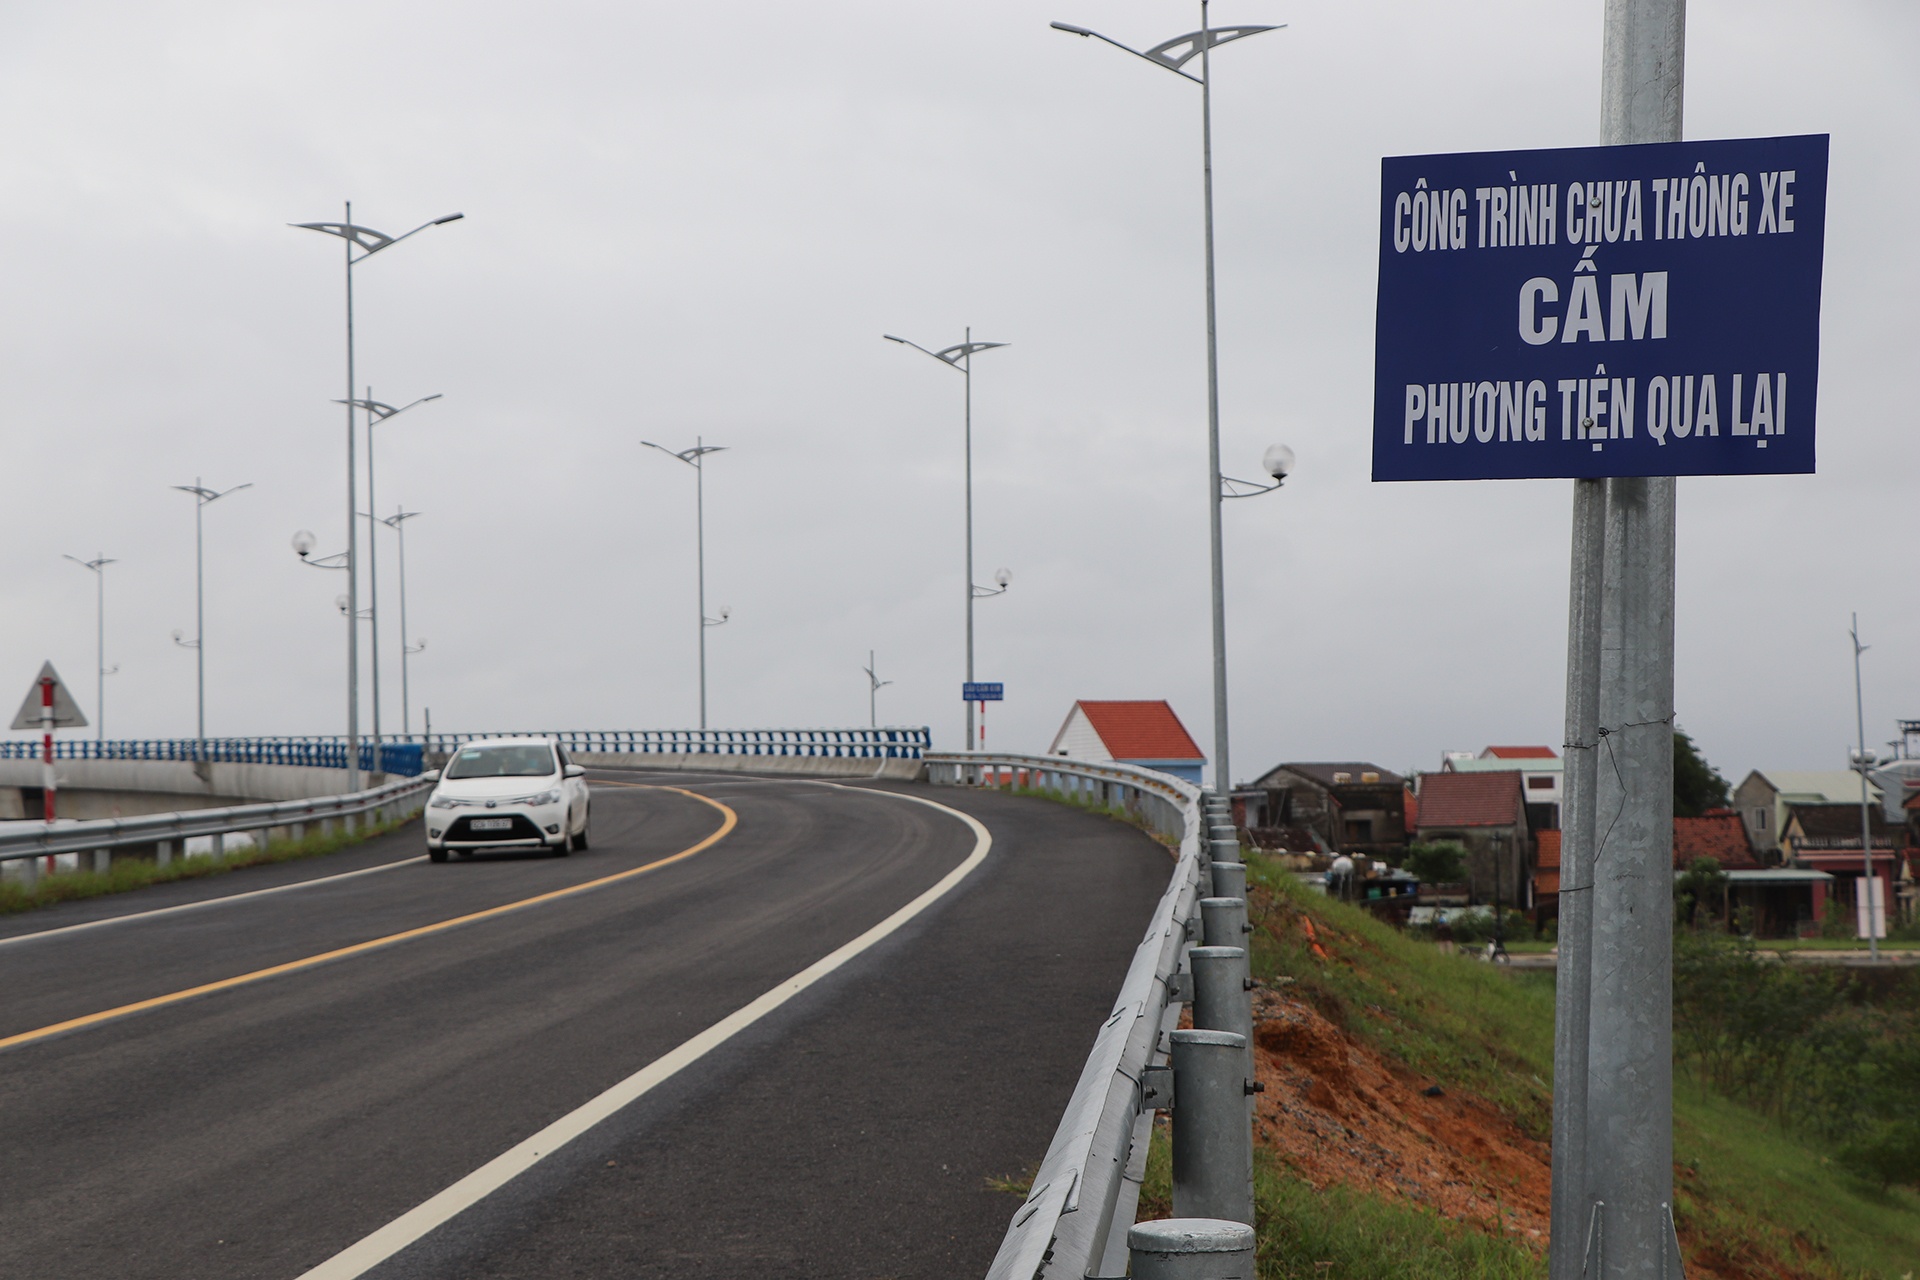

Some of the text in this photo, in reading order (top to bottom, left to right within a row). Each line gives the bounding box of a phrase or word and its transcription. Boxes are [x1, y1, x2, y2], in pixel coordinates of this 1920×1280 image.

[1393, 162, 1796, 254] CÔNG TRÌNH CHƯA THÔNG XE
[1518, 245, 1668, 346] CẤM
[1403, 364, 1787, 452] PHƯƠNG TIỆN QUA LẠI
